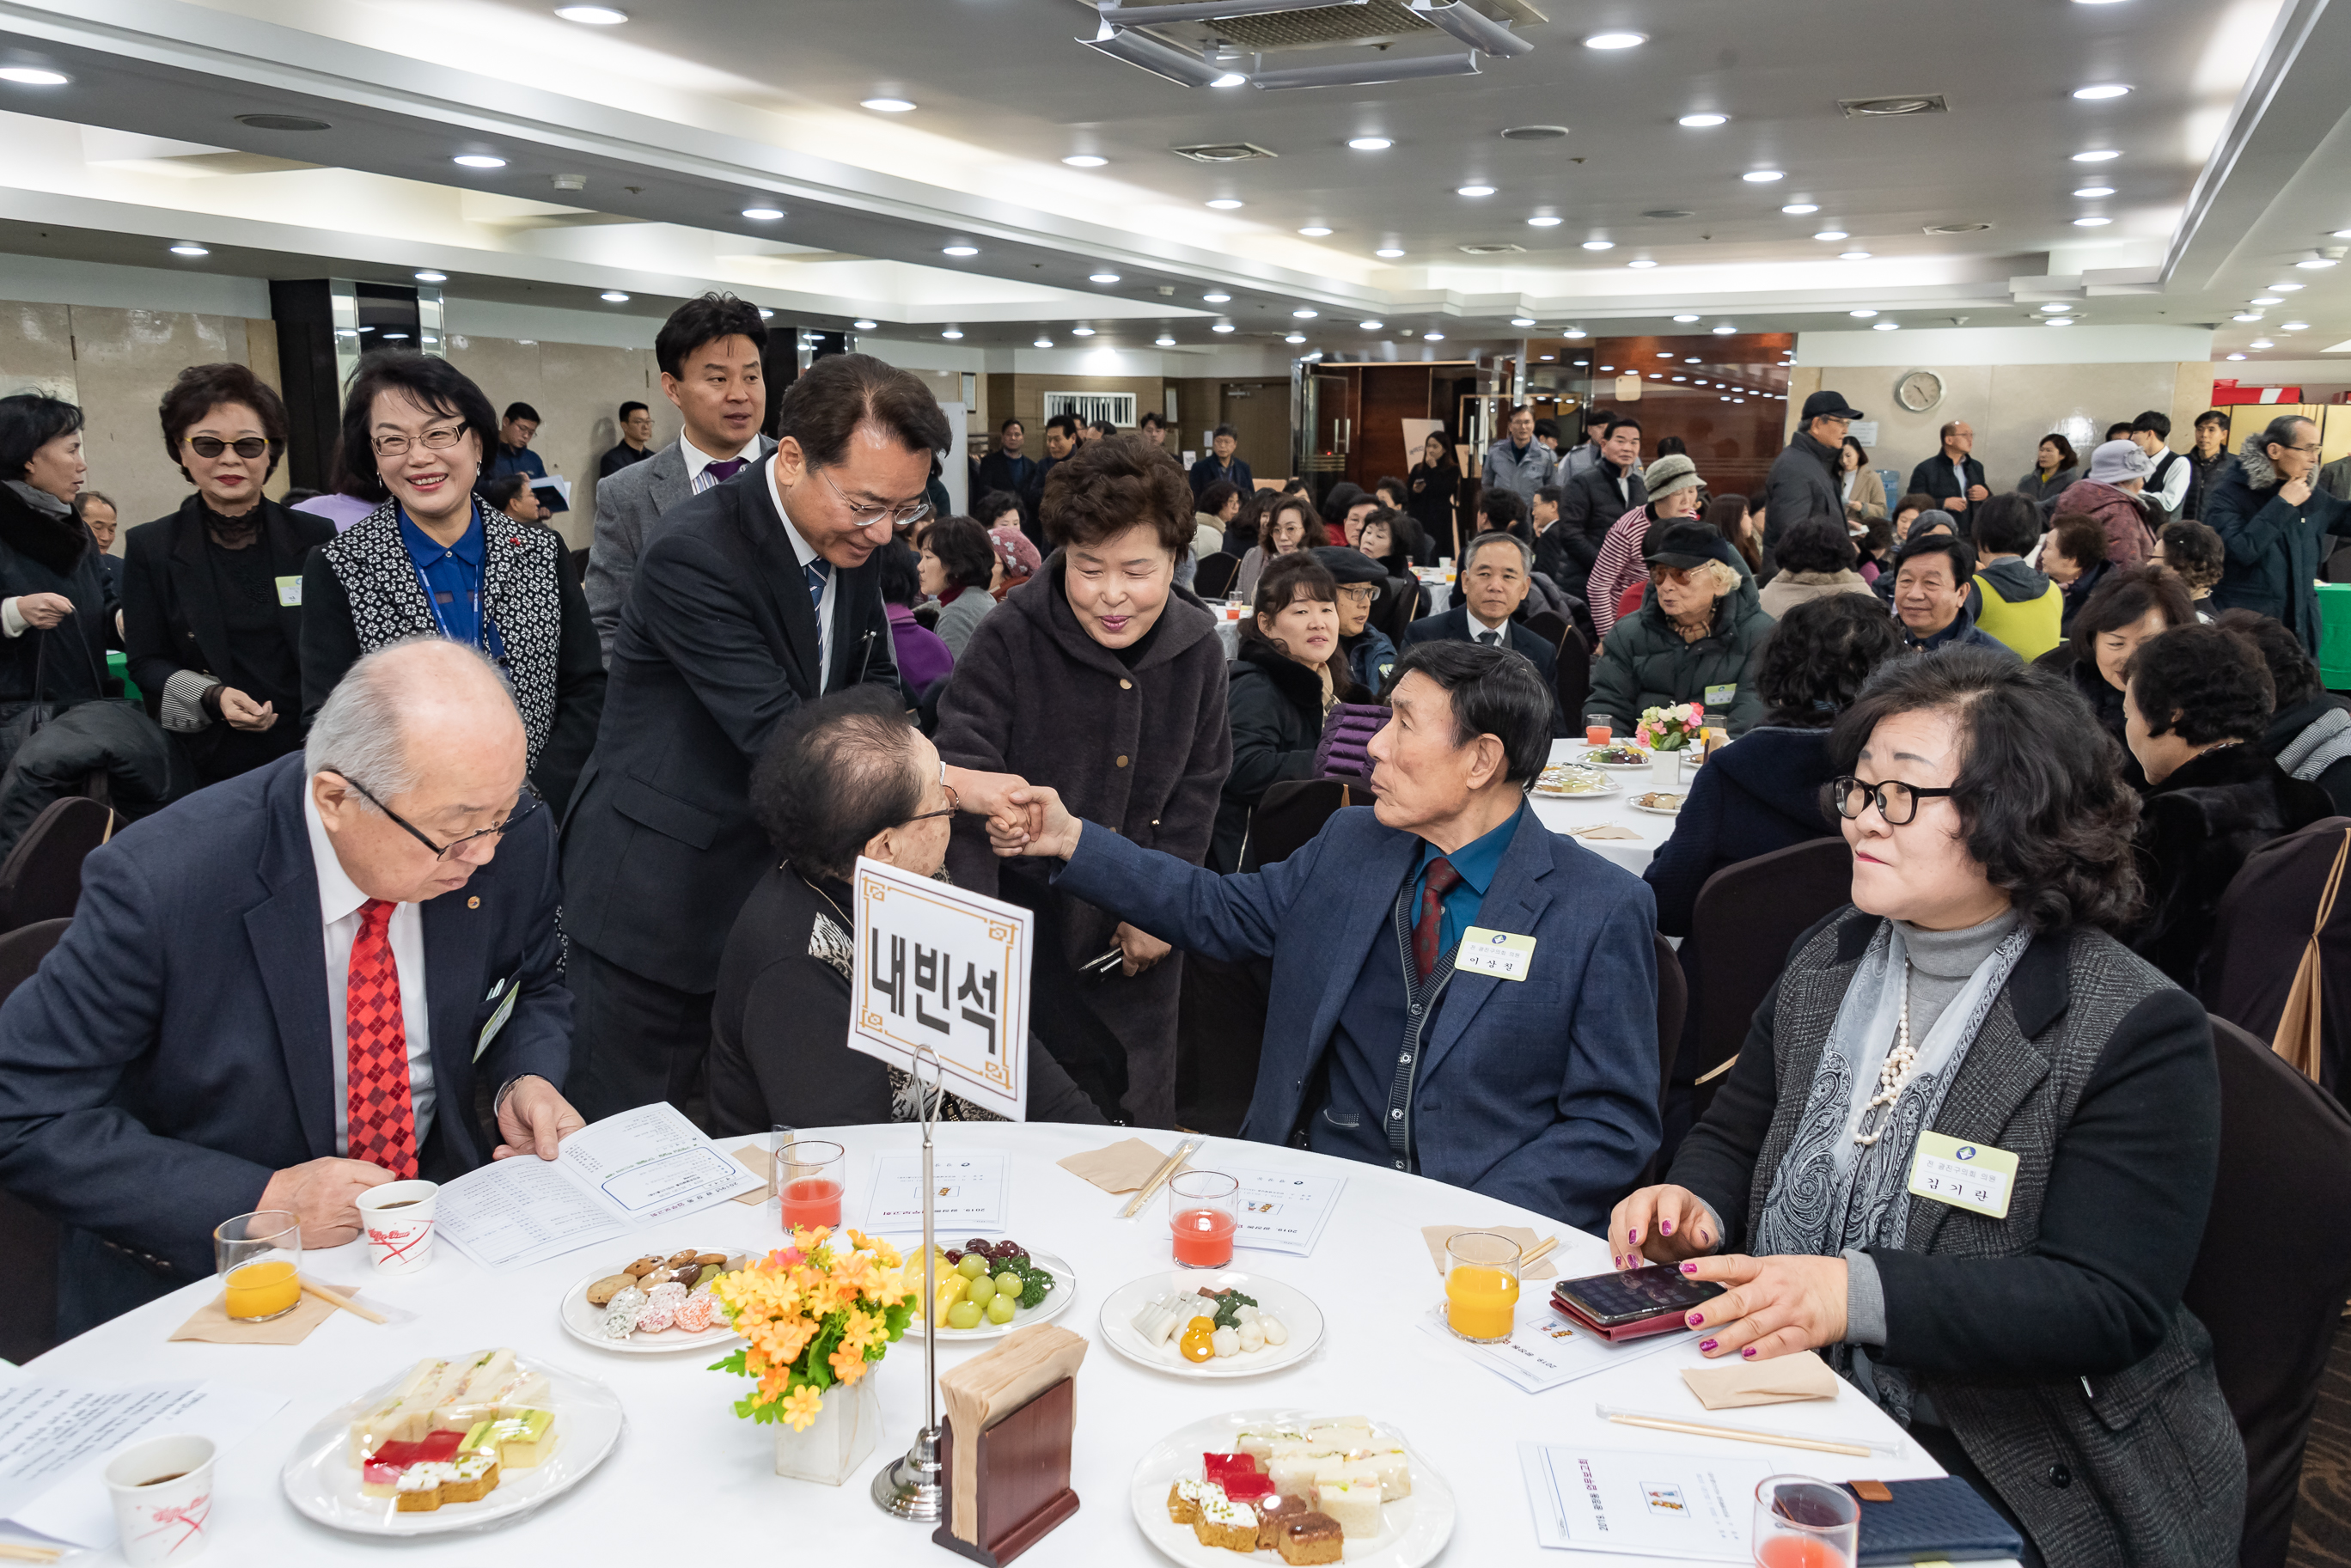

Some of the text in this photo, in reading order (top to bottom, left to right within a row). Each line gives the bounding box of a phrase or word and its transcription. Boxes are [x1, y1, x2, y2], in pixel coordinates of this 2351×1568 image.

[871, 926, 998, 1056] 내빈석
[1927, 1159, 1996, 1183] 전 광진구의회 의원
[1577, 1458, 1597, 1491] 업무보고회
